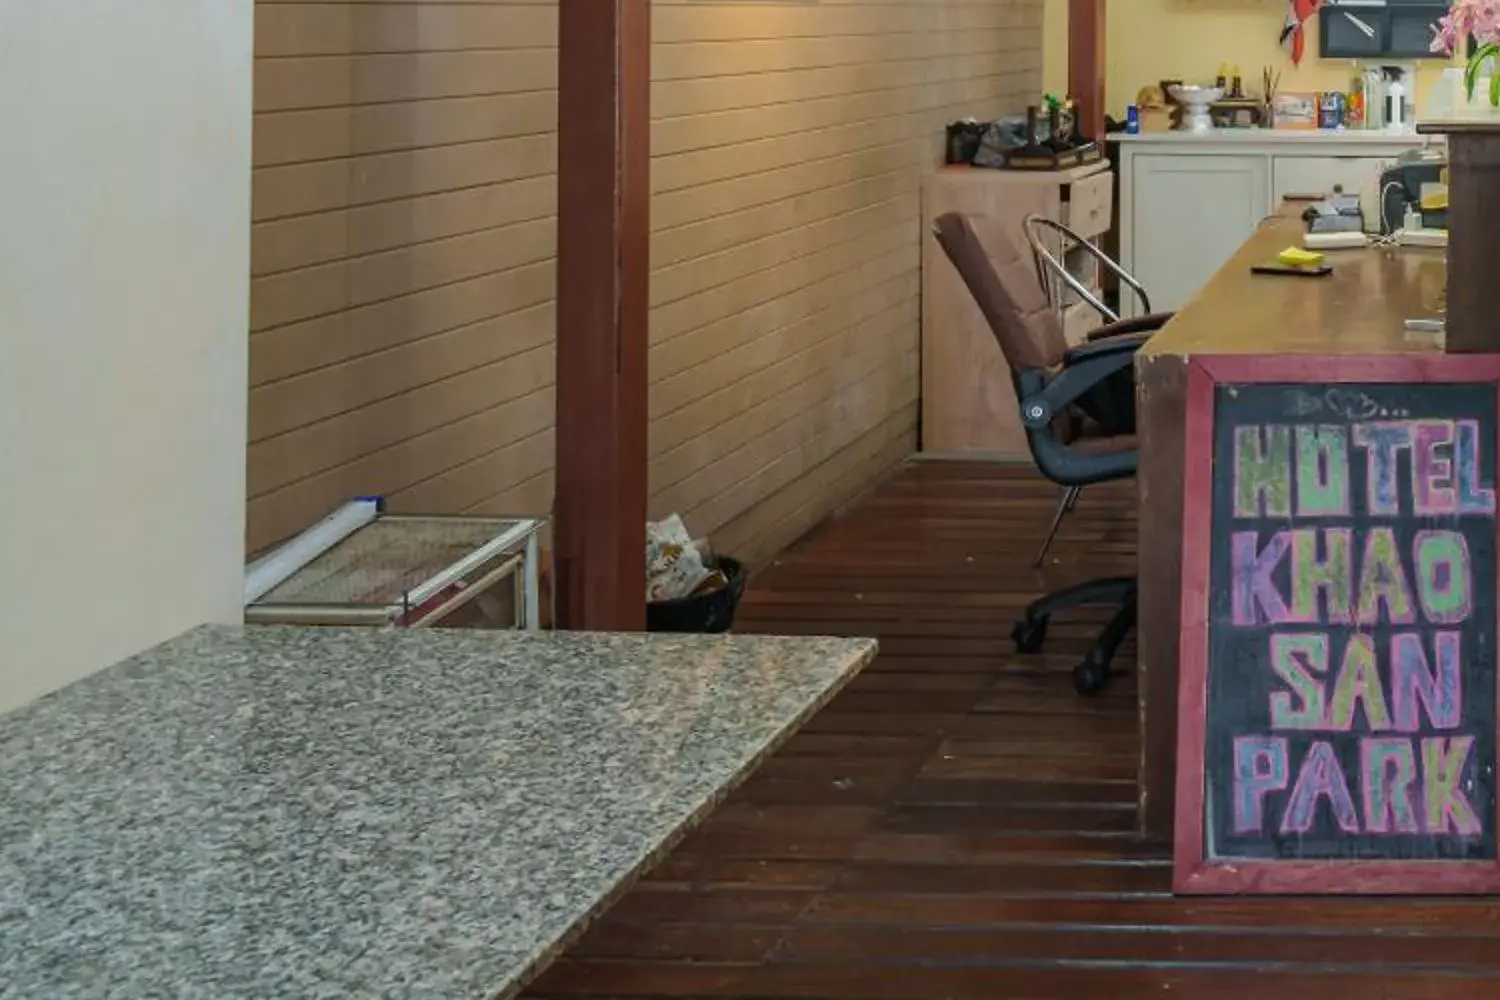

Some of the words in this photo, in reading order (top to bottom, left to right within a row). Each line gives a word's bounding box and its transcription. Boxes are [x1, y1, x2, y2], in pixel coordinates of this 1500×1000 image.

[1233, 419, 1496, 518] HOTEL
[1232, 527, 1473, 626] KHAO
[1269, 631, 1461, 732] SAN
[1232, 735, 1482, 835] PARK
